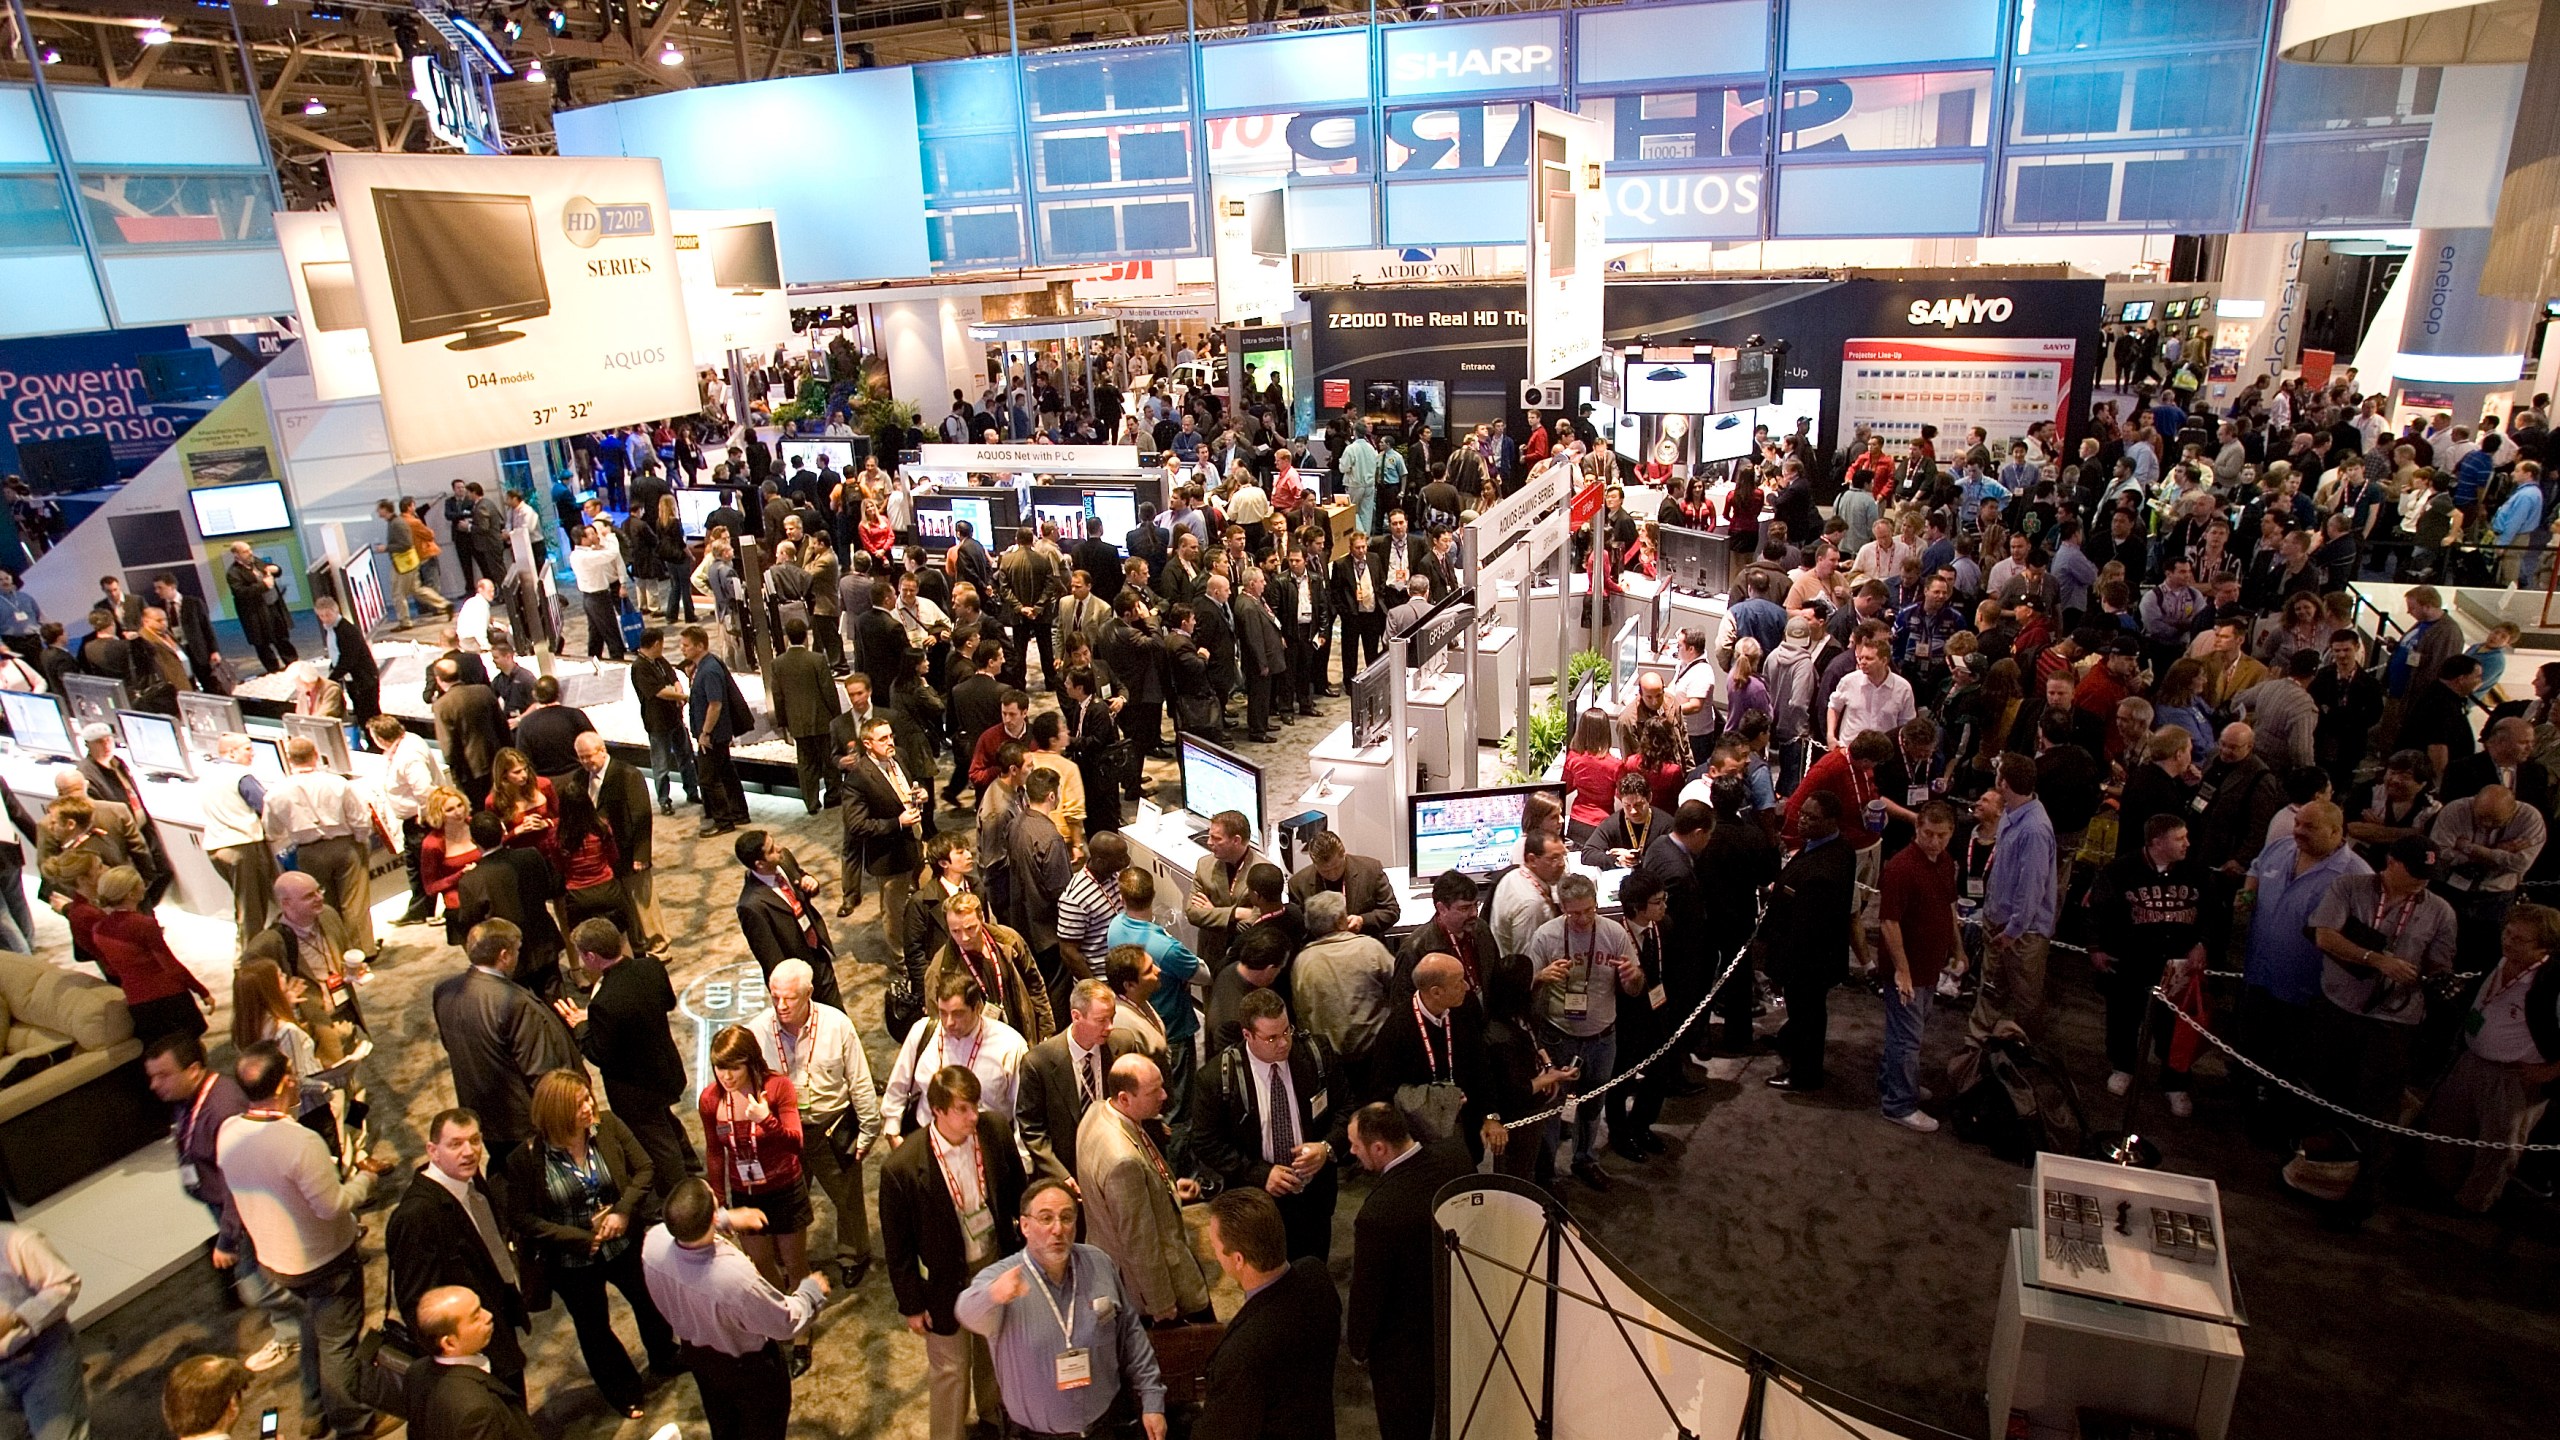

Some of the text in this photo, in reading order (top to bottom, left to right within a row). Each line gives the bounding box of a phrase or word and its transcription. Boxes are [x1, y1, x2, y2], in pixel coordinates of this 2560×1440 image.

[1394, 45, 1552, 81] SHARP
[1603, 173, 1762, 225] QUOS
[567, 210, 645, 232] HD 720P
[587, 257, 652, 278] SERIES
[1153, 308, 1199, 317] Electronics
[1328, 313, 1387, 329] Z2000
[1392, 312, 1424, 328] The
[1429, 311, 1468, 327] Real
[1473, 310, 1499, 326] HD
[1907, 293, 2013, 329] SANYO
[1848, 351, 1903, 361] Projector Line-Up
[2042, 343, 2071, 351] SANYO
[603, 347, 666, 370] AQUOS
[1461, 362, 1496, 371] Entrance
[0, 363, 146, 399] Powerin
[467, 371, 535, 389] D44 models
[12, 387, 137, 424] Global
[532, 401, 593, 426] 37" 32"
[976, 450, 1012, 461] AQUOS
[1014, 450, 1031, 461] Net
[1032, 450, 1052, 461] with
[1499, 508, 1518, 536] AQUOS
[1538, 482, 1555, 507] SERIES
[704, 981, 732, 1010] HD
